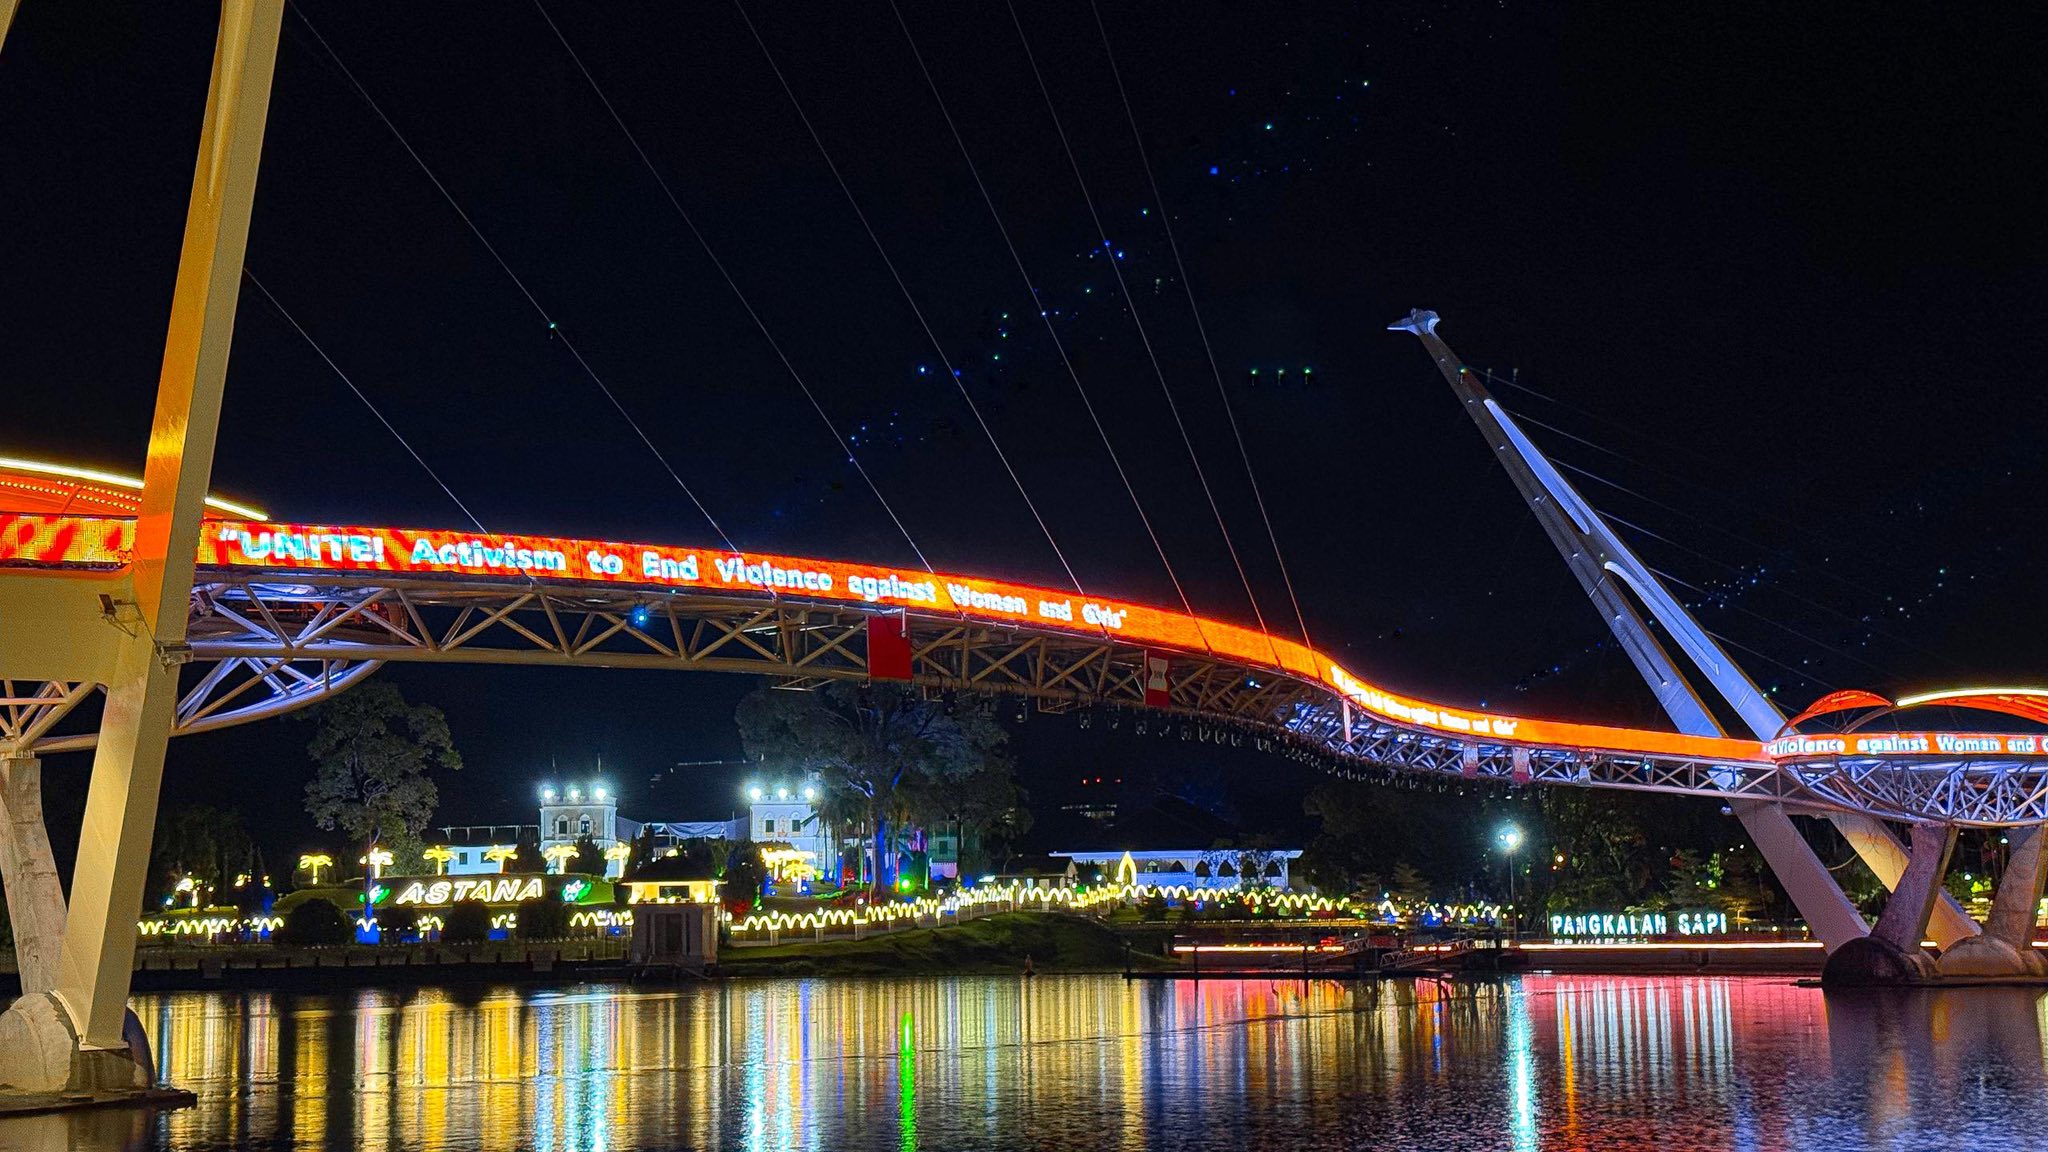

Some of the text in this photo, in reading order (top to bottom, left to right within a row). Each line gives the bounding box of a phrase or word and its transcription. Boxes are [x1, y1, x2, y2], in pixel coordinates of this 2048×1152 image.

[411, 538, 566, 571] Activism
[587, 550, 624, 574] to
[642, 552, 699, 580] End
[848, 574, 937, 602] against
[1039, 600, 1073, 621] and
[1856, 736, 1929, 755] against
[2007, 736, 2035, 752] and
[396, 879, 543, 904] ASTANA
[1551, 913, 1727, 935] PANGKALAN SAPI
